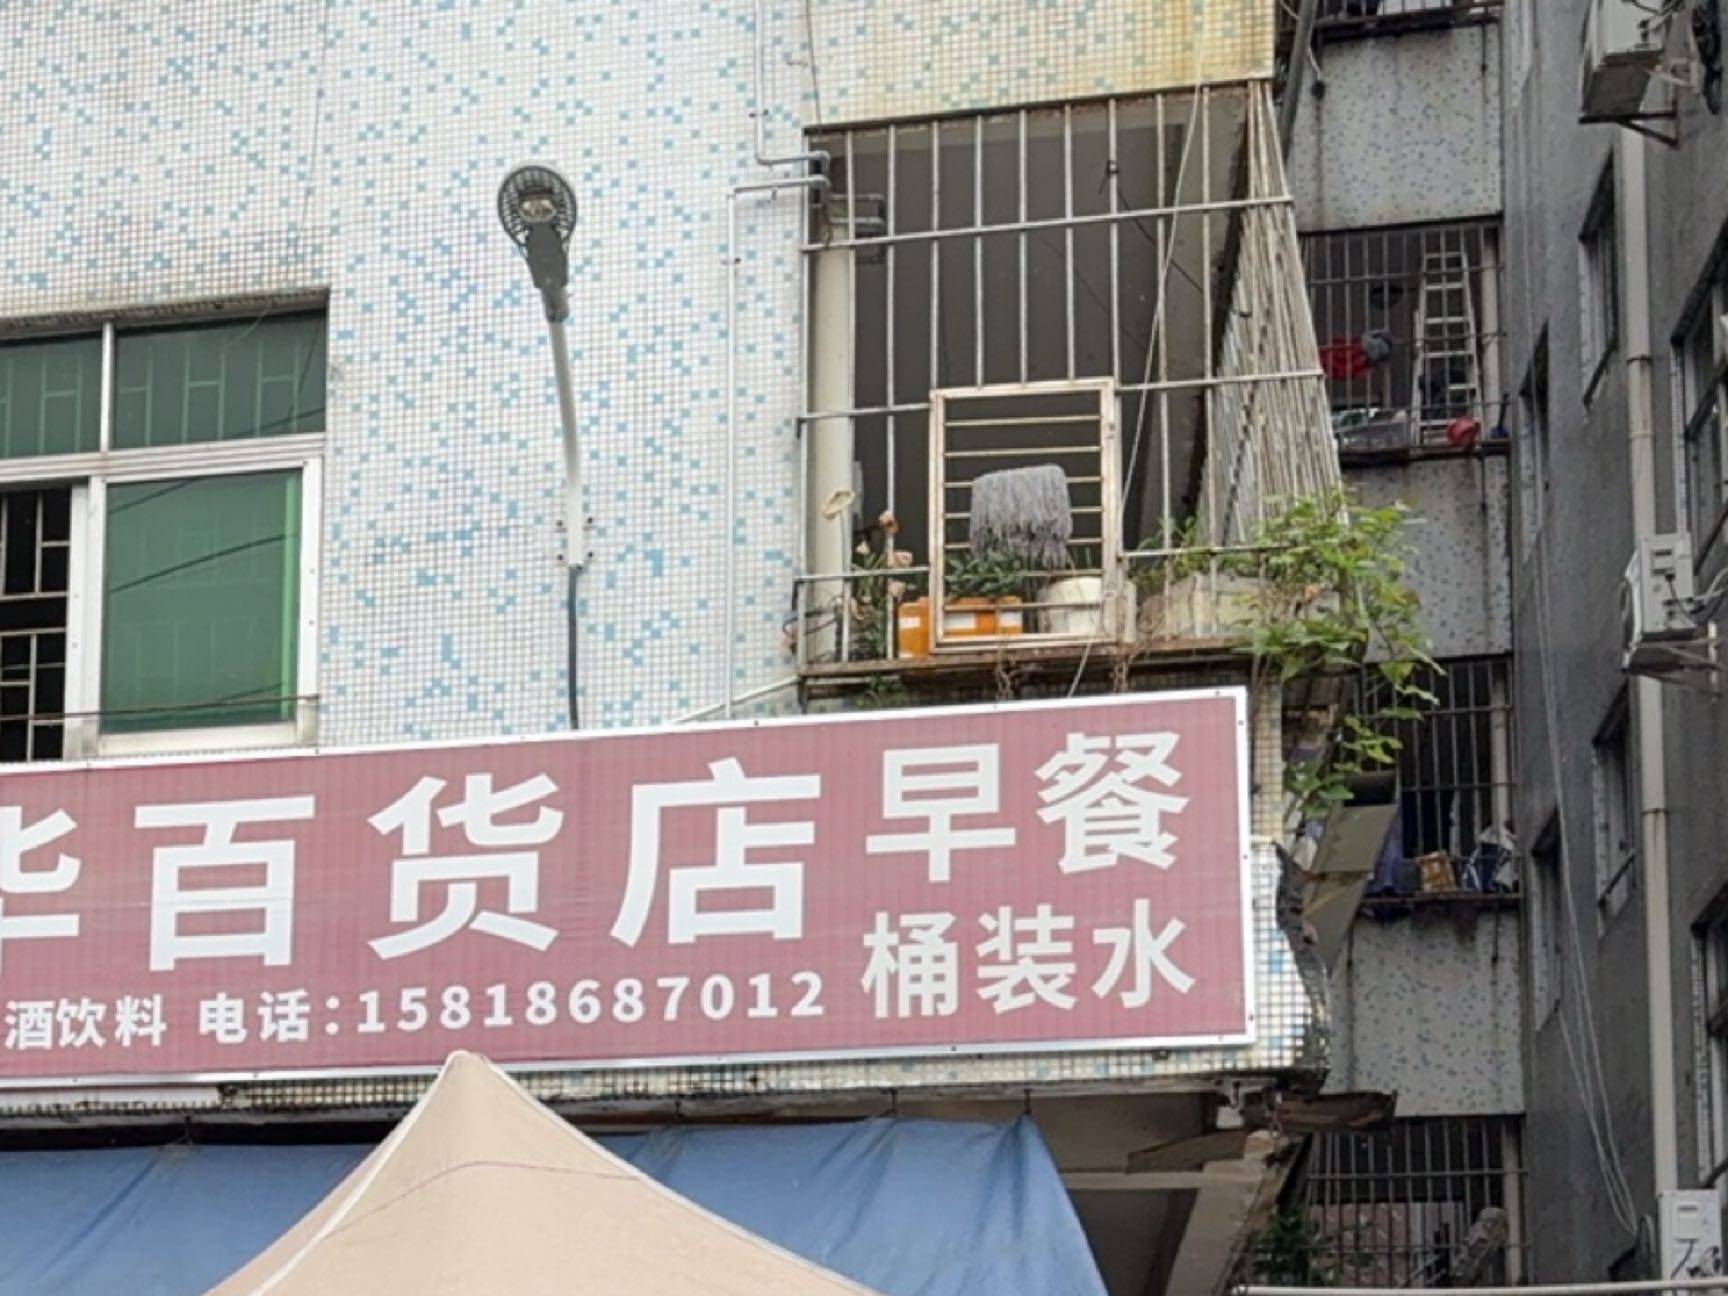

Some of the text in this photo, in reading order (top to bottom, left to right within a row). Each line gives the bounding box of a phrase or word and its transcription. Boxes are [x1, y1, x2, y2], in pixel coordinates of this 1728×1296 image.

[865, 731, 1190, 882] 早餐
[860, 899, 1196, 1019] 桶装水
[5, 997, 168, 1053] 酒饮料
